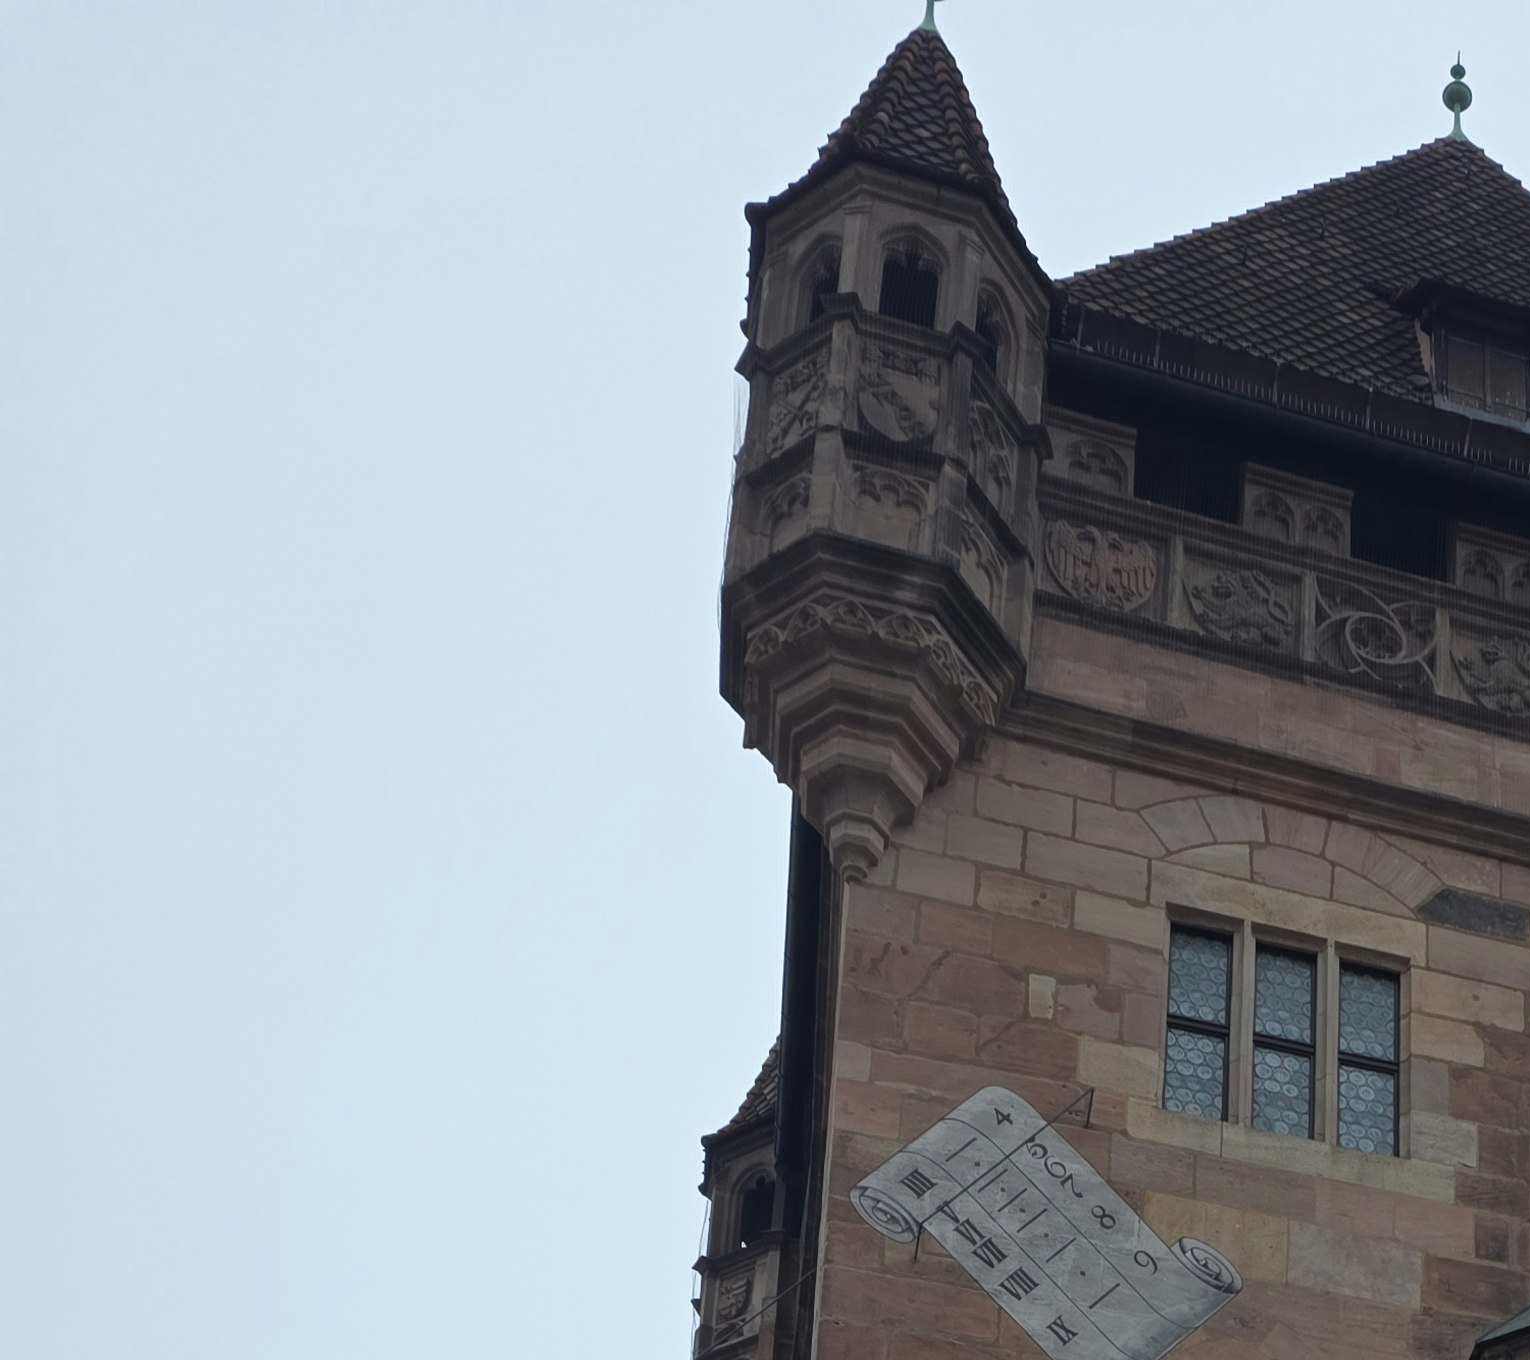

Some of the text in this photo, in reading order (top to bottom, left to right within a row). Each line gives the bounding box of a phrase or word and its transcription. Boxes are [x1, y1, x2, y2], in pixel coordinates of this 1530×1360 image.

[994, 1107, 1013, 1126] 4
[1044, 1154, 1067, 1178] 6
[1090, 1205, 1116, 1230] 8
[953, 1218, 988, 1247] VI
[972, 1237, 1009, 1269] VII
[1133, 1250, 1158, 1276] 9
[999, 1266, 1041, 1302] VIII
[1046, 1314, 1080, 1346] IX
